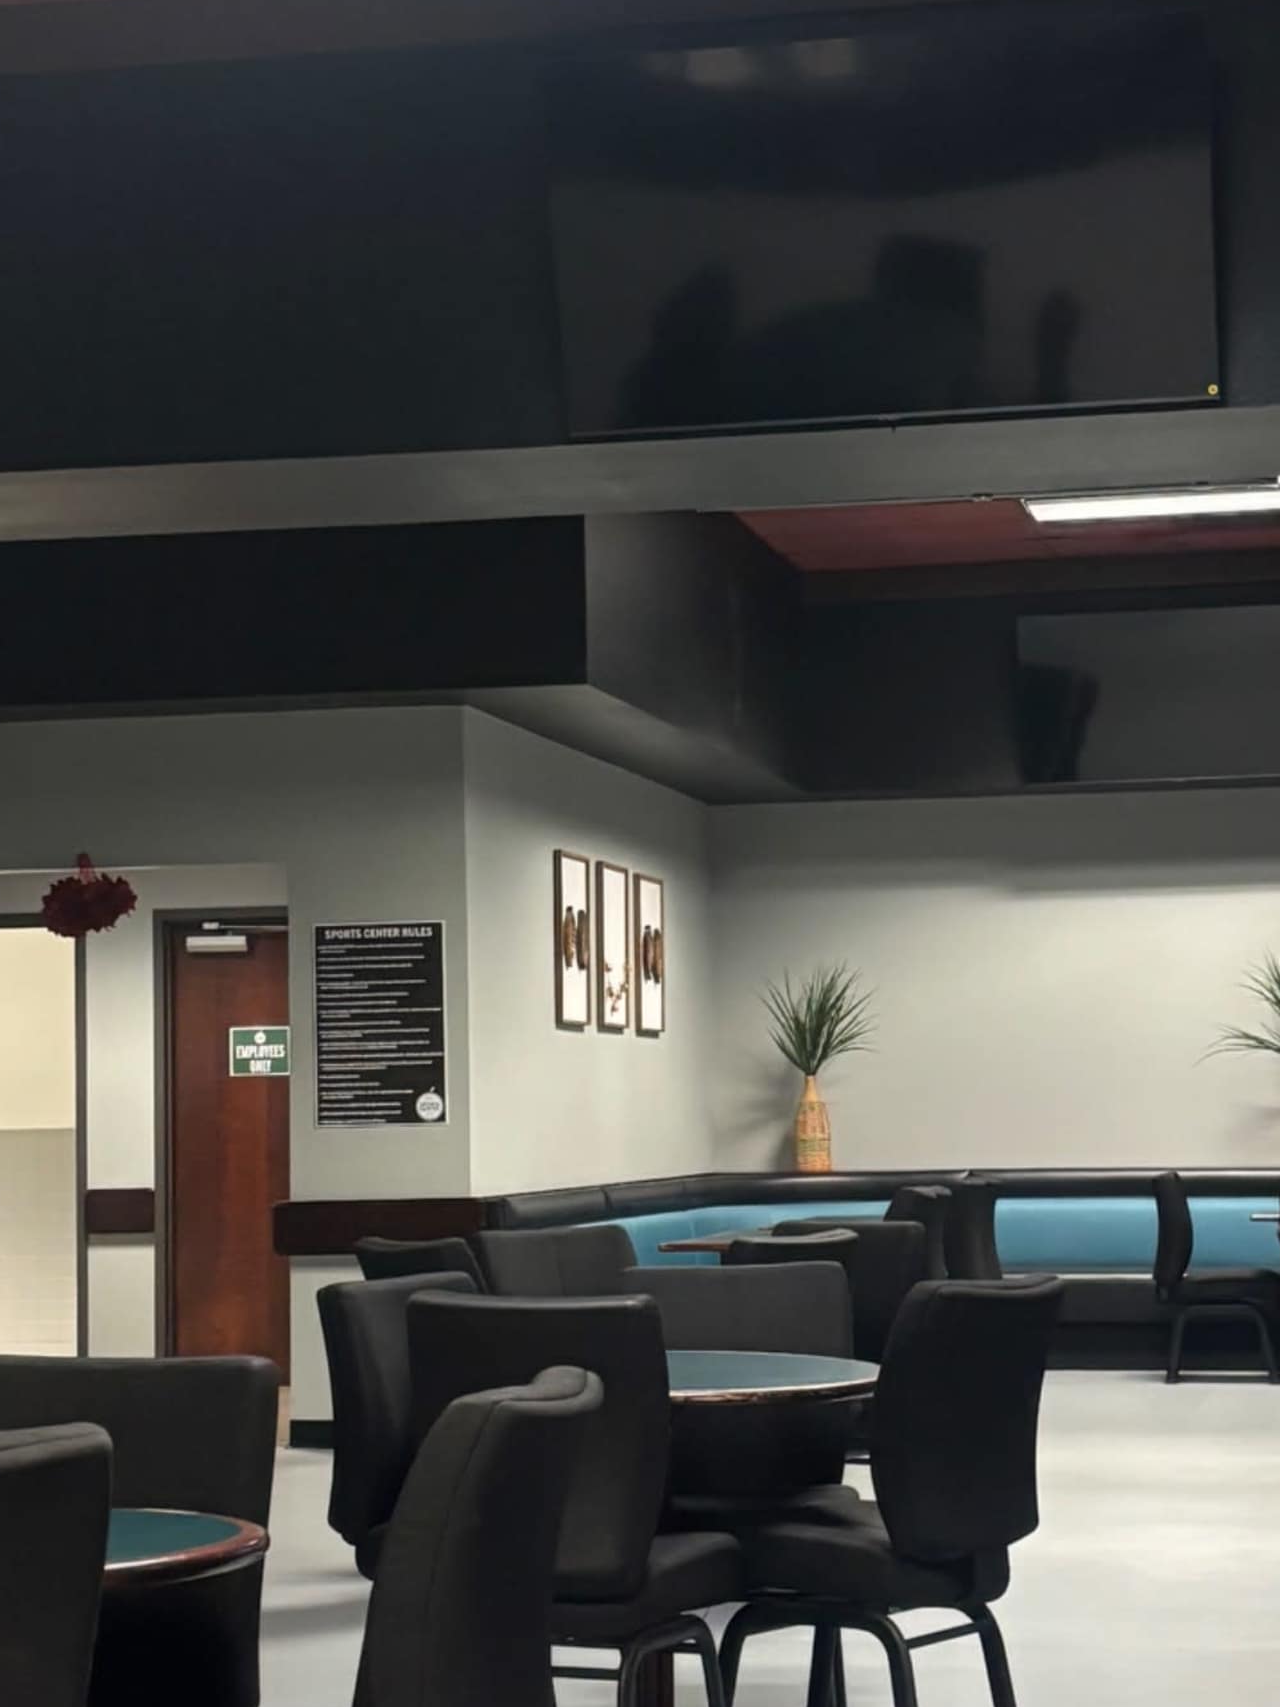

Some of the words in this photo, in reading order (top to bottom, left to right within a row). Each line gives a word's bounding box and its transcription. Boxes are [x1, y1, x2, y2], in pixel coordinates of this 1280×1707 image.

[324, 929, 362, 940] SPORTS
[363, 927, 401, 939] CENTER
[402, 926, 433, 937] RULES
[236, 1045, 285, 1059] EMPLOYEES
[250, 1060, 271, 1073] ONLY
